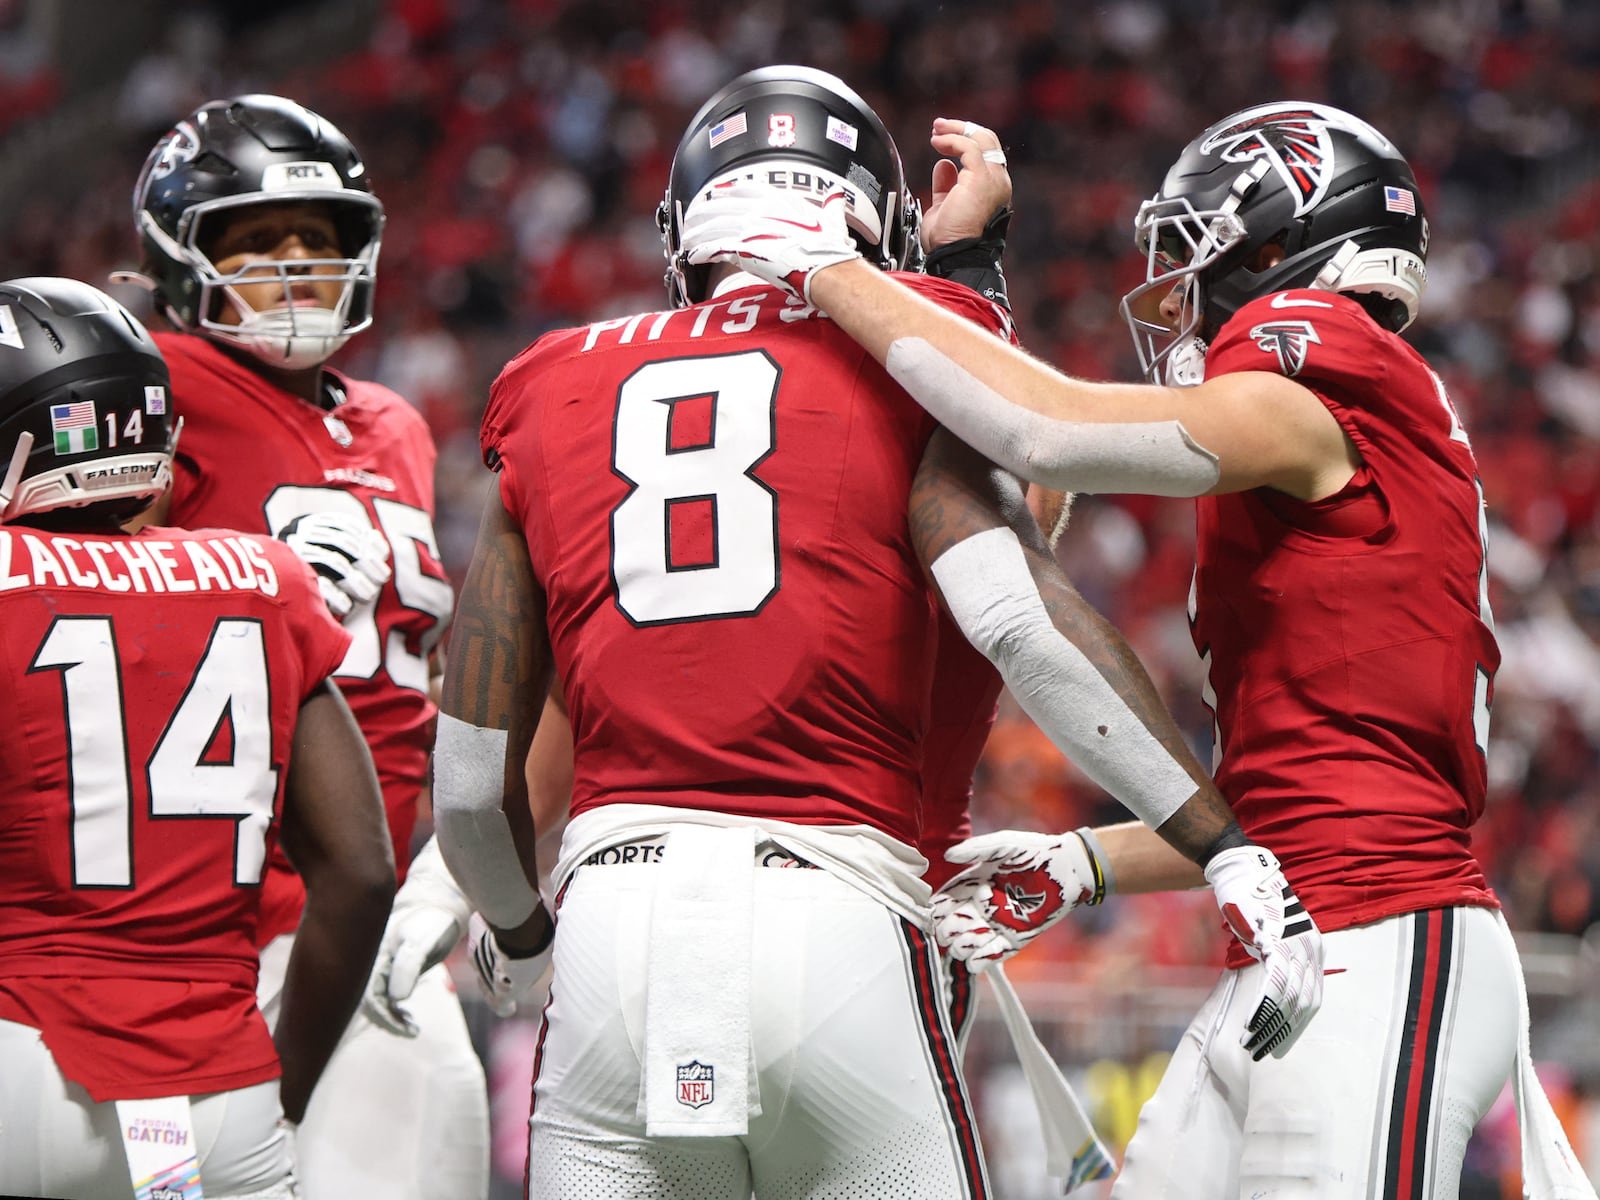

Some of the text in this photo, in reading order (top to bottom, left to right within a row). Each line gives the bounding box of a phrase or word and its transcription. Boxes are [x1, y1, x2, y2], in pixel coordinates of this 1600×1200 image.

[767, 113, 796, 147] 8
[580, 293, 769, 353] PITTS
[105, 409, 144, 448] 14
[87, 464, 157, 480] FALCONS
[609, 348, 783, 629] 8
[0, 530, 280, 598] ZACCHEAUS
[26, 615, 279, 889] 14
[1257, 854, 1269, 867] 8
[680, 1082, 709, 1103] NFL
[127, 1126, 189, 1147] CATCH
